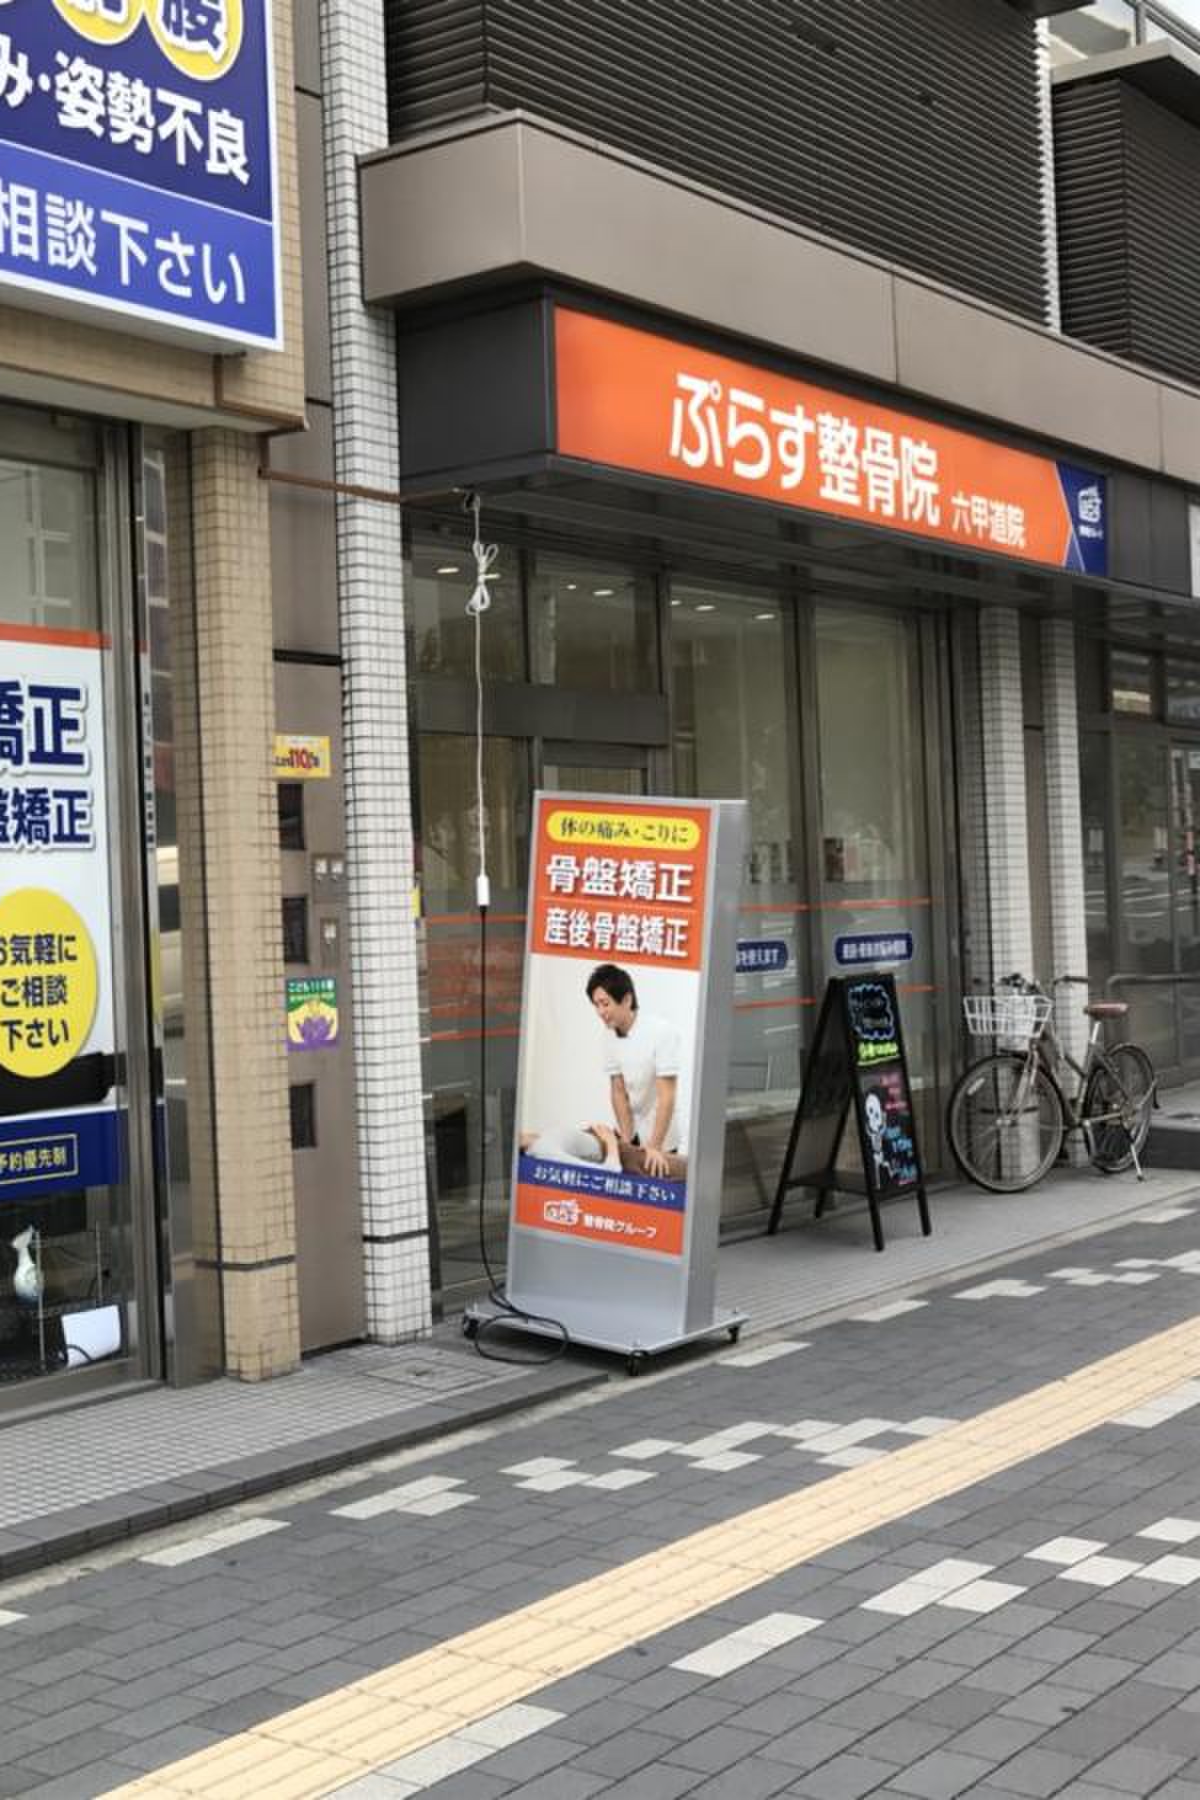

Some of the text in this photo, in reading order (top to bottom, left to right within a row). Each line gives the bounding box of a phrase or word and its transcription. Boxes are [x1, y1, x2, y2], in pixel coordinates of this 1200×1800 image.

[669, 372, 1027, 549] ぷらす整骨院 六甲道院
[560, 816, 689, 844] 体の痛み・こりに
[545, 854, 695, 903] 骨盤矯正
[544, 907, 689, 958] 産後骨盤矯正
[1, 974, 68, 1008] ご相談
[1, 1018, 70, 1052] 下さい
